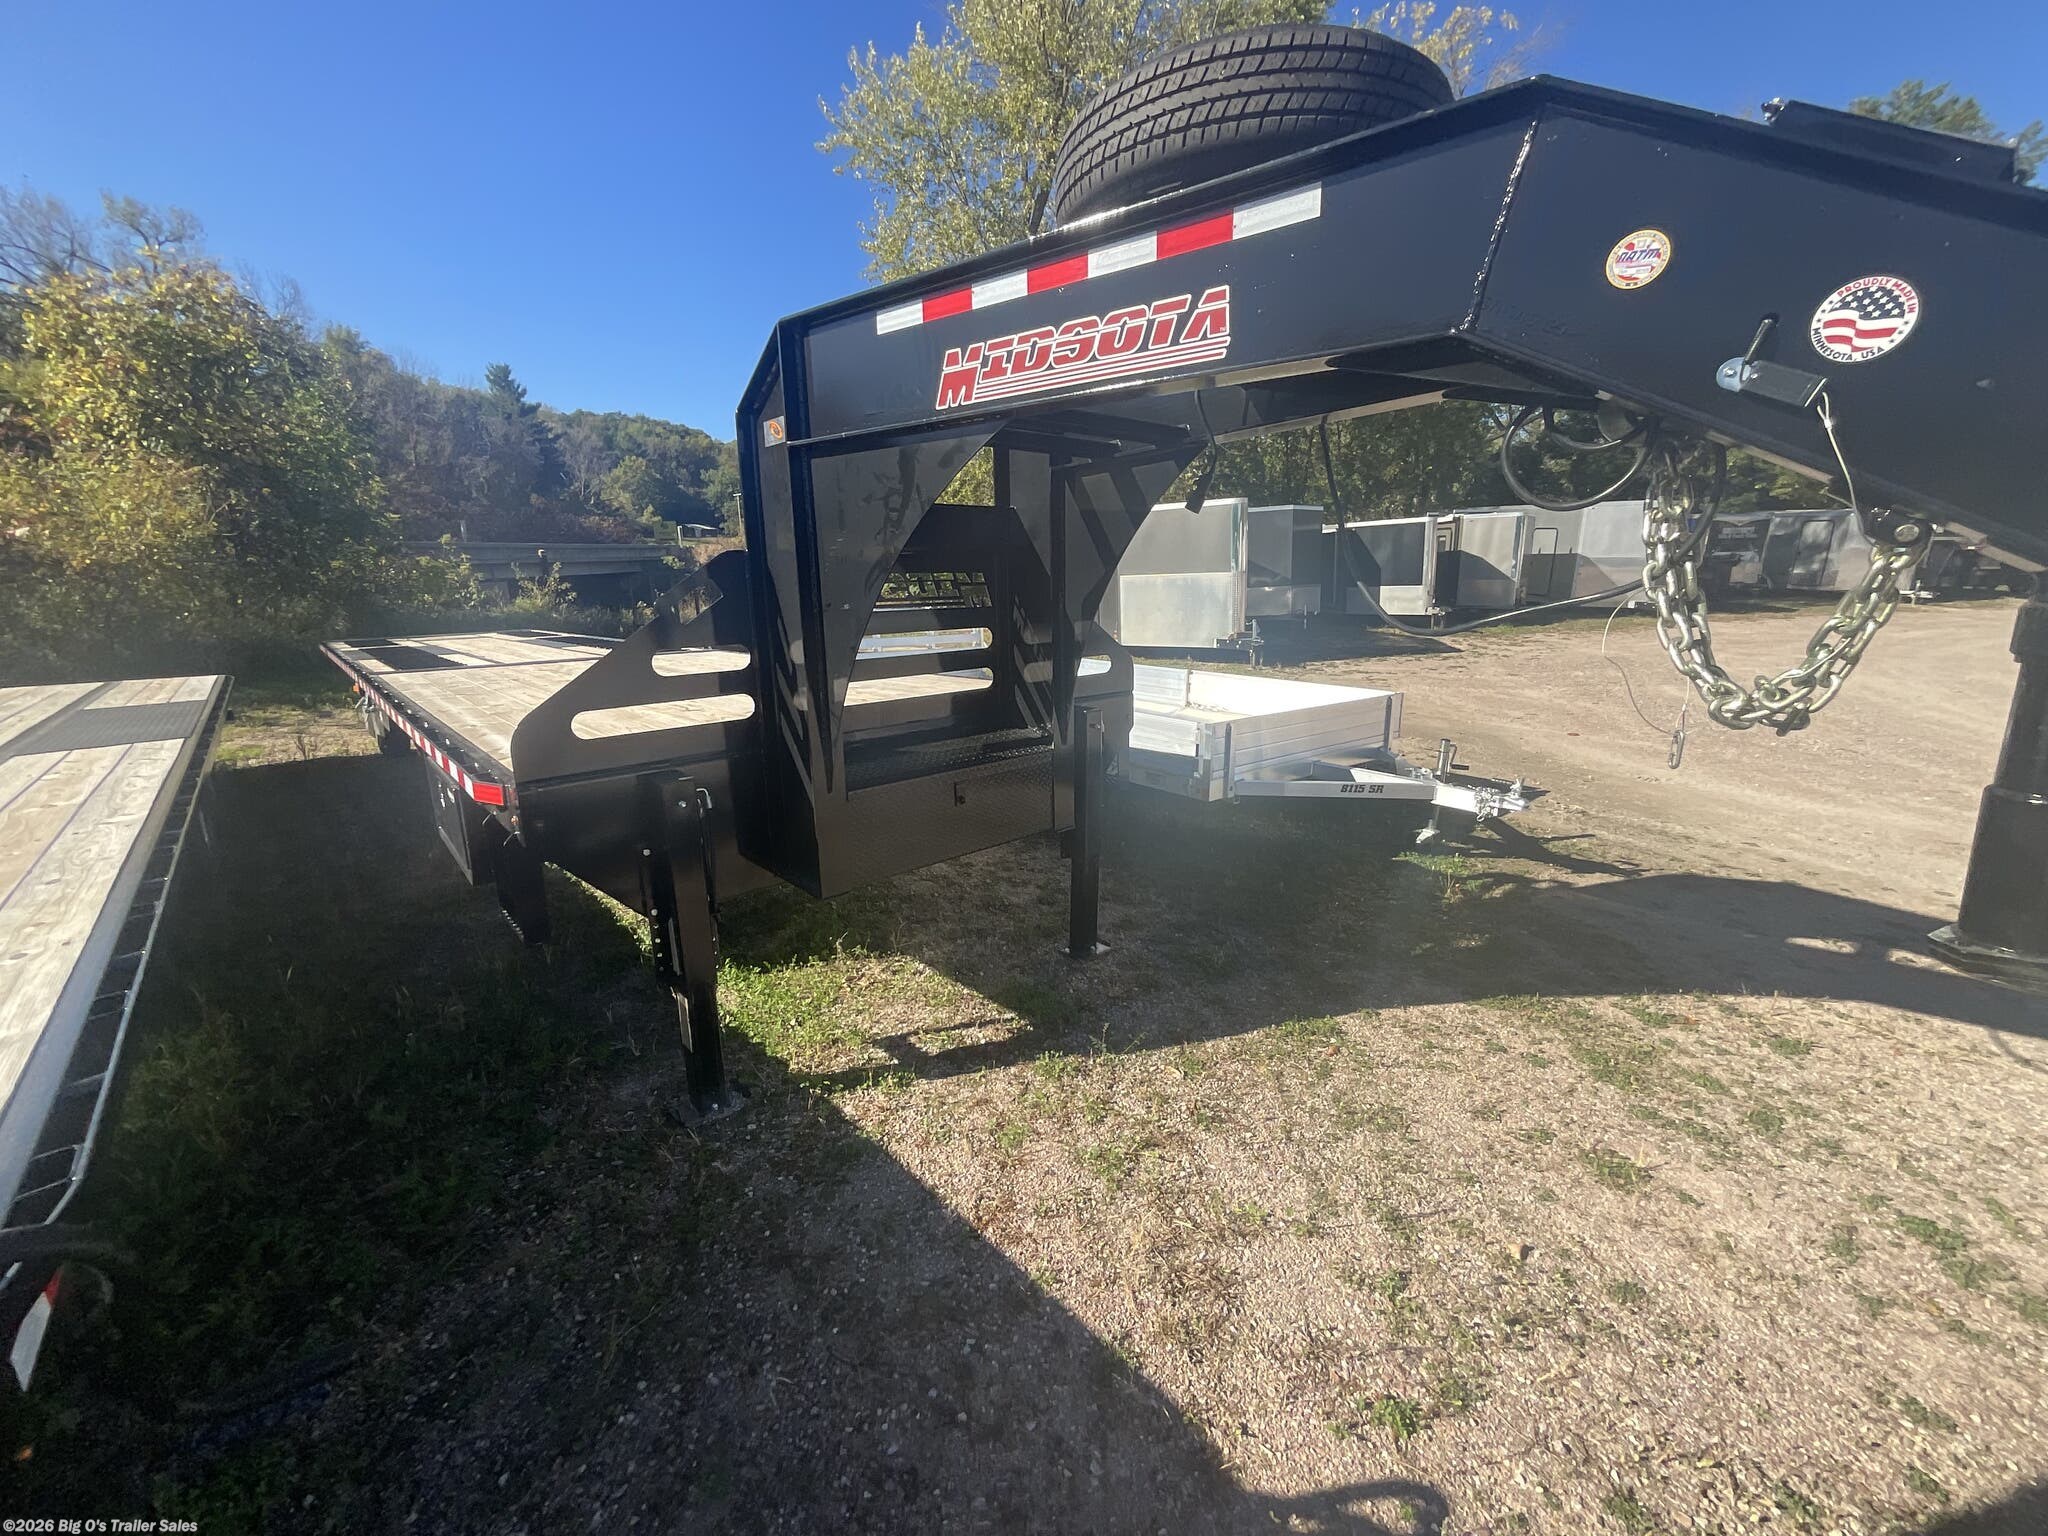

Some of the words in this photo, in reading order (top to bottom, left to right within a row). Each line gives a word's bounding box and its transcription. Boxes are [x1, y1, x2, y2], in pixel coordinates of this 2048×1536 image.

[1837, 278, 1892, 297] PROUDLY
[1892, 280, 1917, 303] MADE
[1907, 302, 1917, 313] IN
[936, 285, 1229, 410] MIDSOTA
[1861, 347, 1884, 358] USA
[1368, 784, 1384, 794] SR
